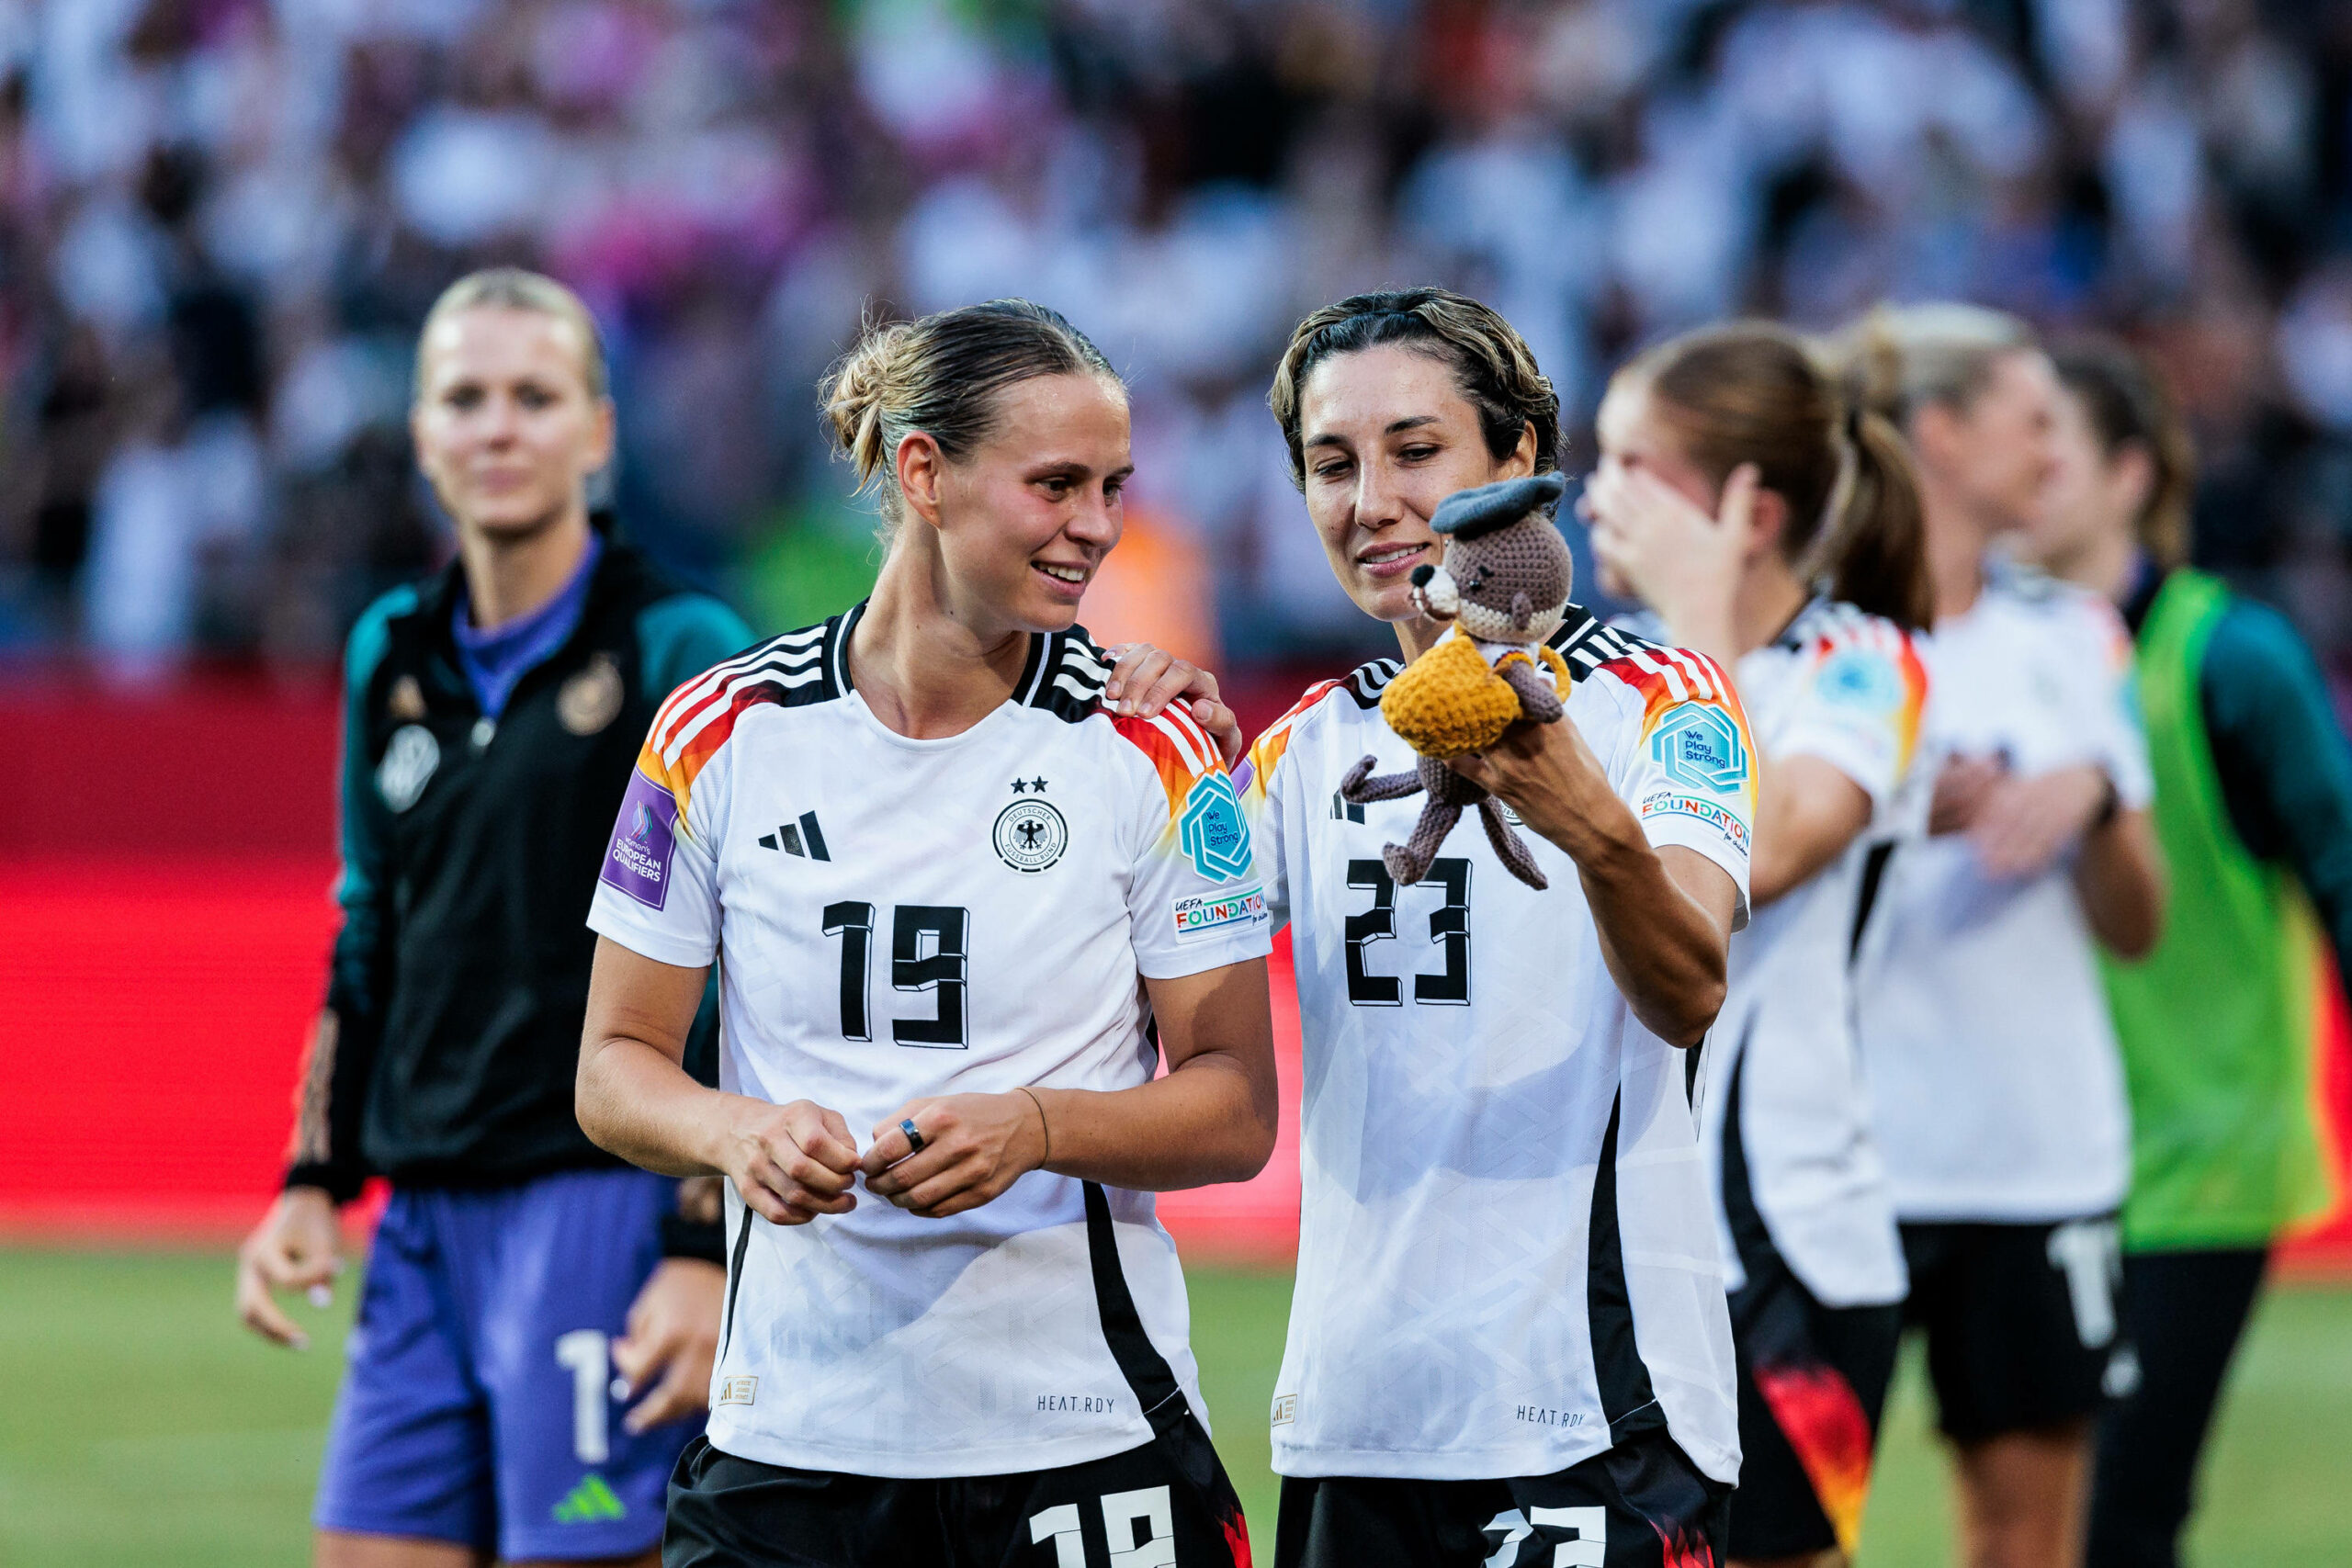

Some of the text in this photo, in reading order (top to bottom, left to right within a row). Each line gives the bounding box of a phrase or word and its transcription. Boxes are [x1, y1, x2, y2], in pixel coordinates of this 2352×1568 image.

[1684, 730, 1703, 740] We
[1685, 741, 1712, 754] Play
[1686, 751, 1725, 768] Strong
[1643, 792, 1671, 804] UEFA
[1009, 808, 1052, 822] DEUTSCHER
[1206, 810, 1220, 820] We
[1208, 823, 1227, 834] Play
[1211, 831, 1238, 846] Strong
[616, 838, 662, 871] EUROPEAN
[613, 849, 661, 882] QUALIFIERS
[1175, 897, 1203, 912] UEFA
[1345, 858, 1473, 1007] 23
[821, 900, 970, 1050] 19
[555, 1328, 610, 1462] 1
[1037, 1395, 1114, 1414] HEAT.RDY
[1517, 1404, 1586, 1427] HEAT.RDY
